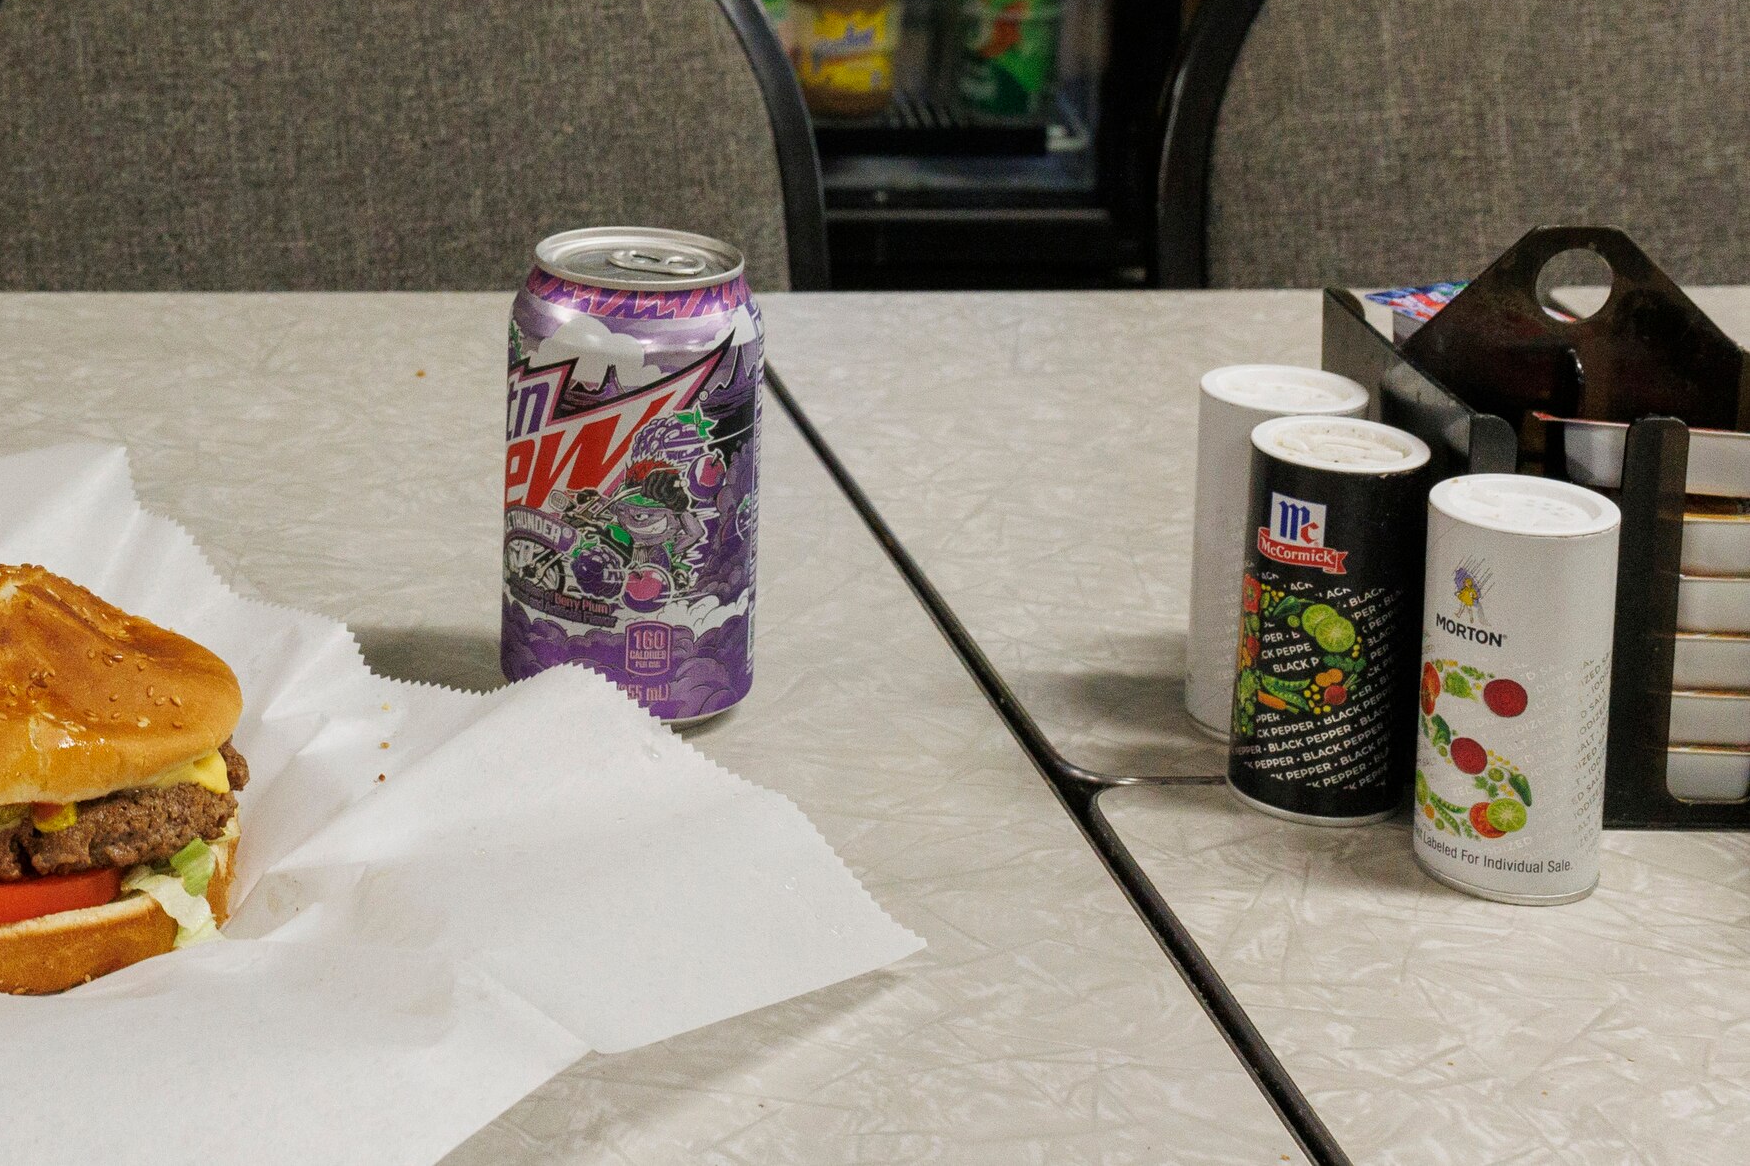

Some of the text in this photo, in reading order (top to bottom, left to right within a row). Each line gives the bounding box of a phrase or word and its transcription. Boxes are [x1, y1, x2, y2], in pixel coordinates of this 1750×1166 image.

[1259, 537, 1336, 566] McCormick
[554, 591, 581, 610] Berry
[582, 597, 609, 614] Plum
[633, 629, 666, 650] 160
[1436, 612, 1503, 648] MORTON
[630, 650, 667, 660] CALORIES
[1272, 658, 1309, 674] BLACK
[1271, 720, 1315, 736] PEPPER
[1323, 705, 1362, 726] BLACK
[1254, 721, 1385, 770] PEPPER BLACK PEPPER
[1267, 738, 1303, 754] BLACK
[1306, 724, 1352, 745] PEPPER
[1285, 742, 1377, 781] PEPPER BLACK
[1323, 763, 1367, 788] PEPPER
[1423, 831, 1458, 860] Labeled
[1461, 848, 1480, 866] For
[1483, 854, 1544, 874] Individual
[1547, 859, 1573, 874] Sale.
